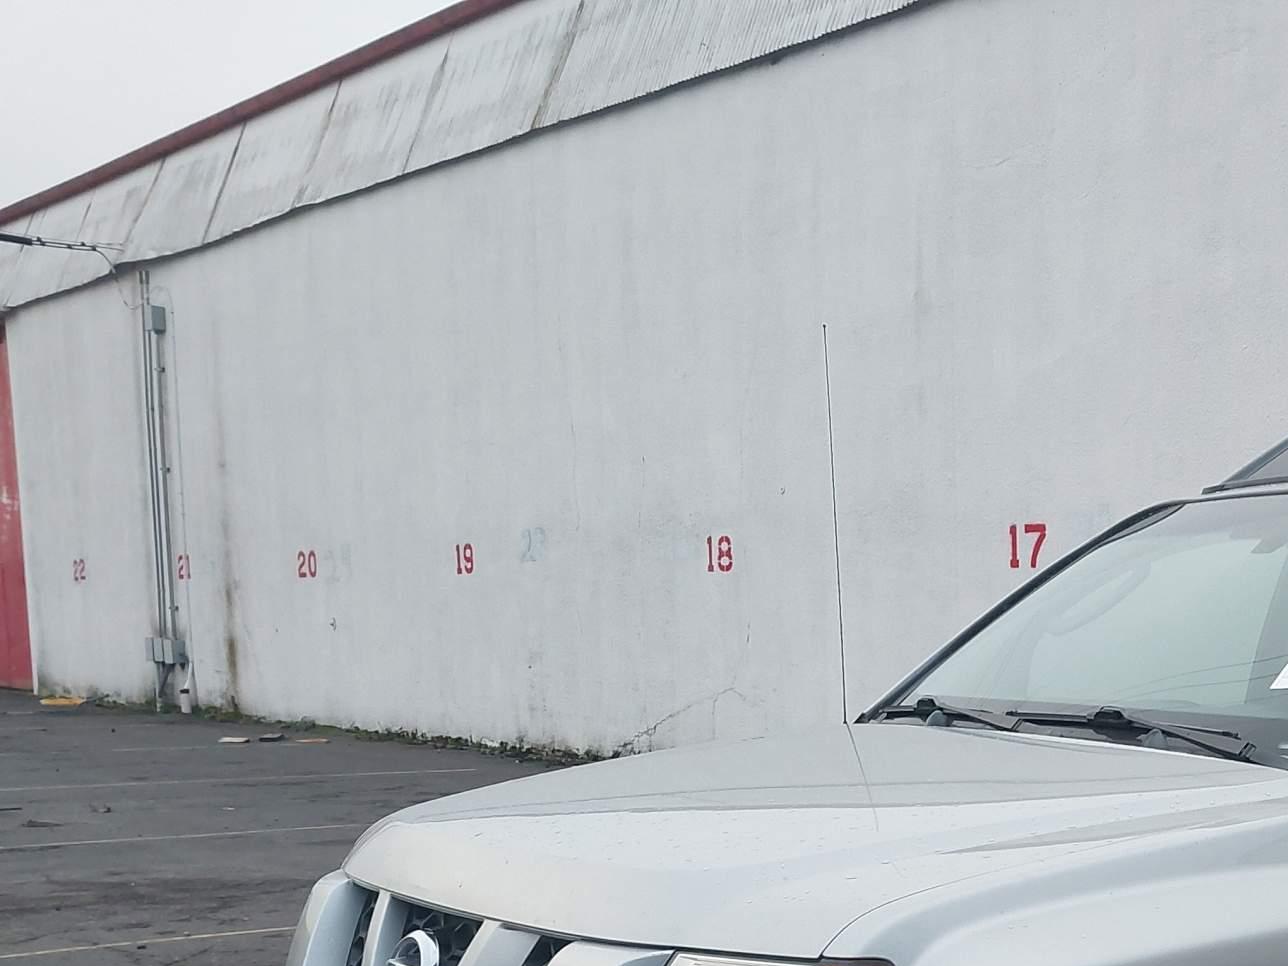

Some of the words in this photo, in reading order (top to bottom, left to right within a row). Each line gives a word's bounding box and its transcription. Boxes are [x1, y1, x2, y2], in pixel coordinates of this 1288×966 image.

[455, 543, 474, 575] 19
[706, 535, 733, 573] 18
[1008, 523, 1047, 569] 17
[72, 558, 87, 582] 22
[177, 554, 191, 580] 21
[297, 550, 317, 578] 20
